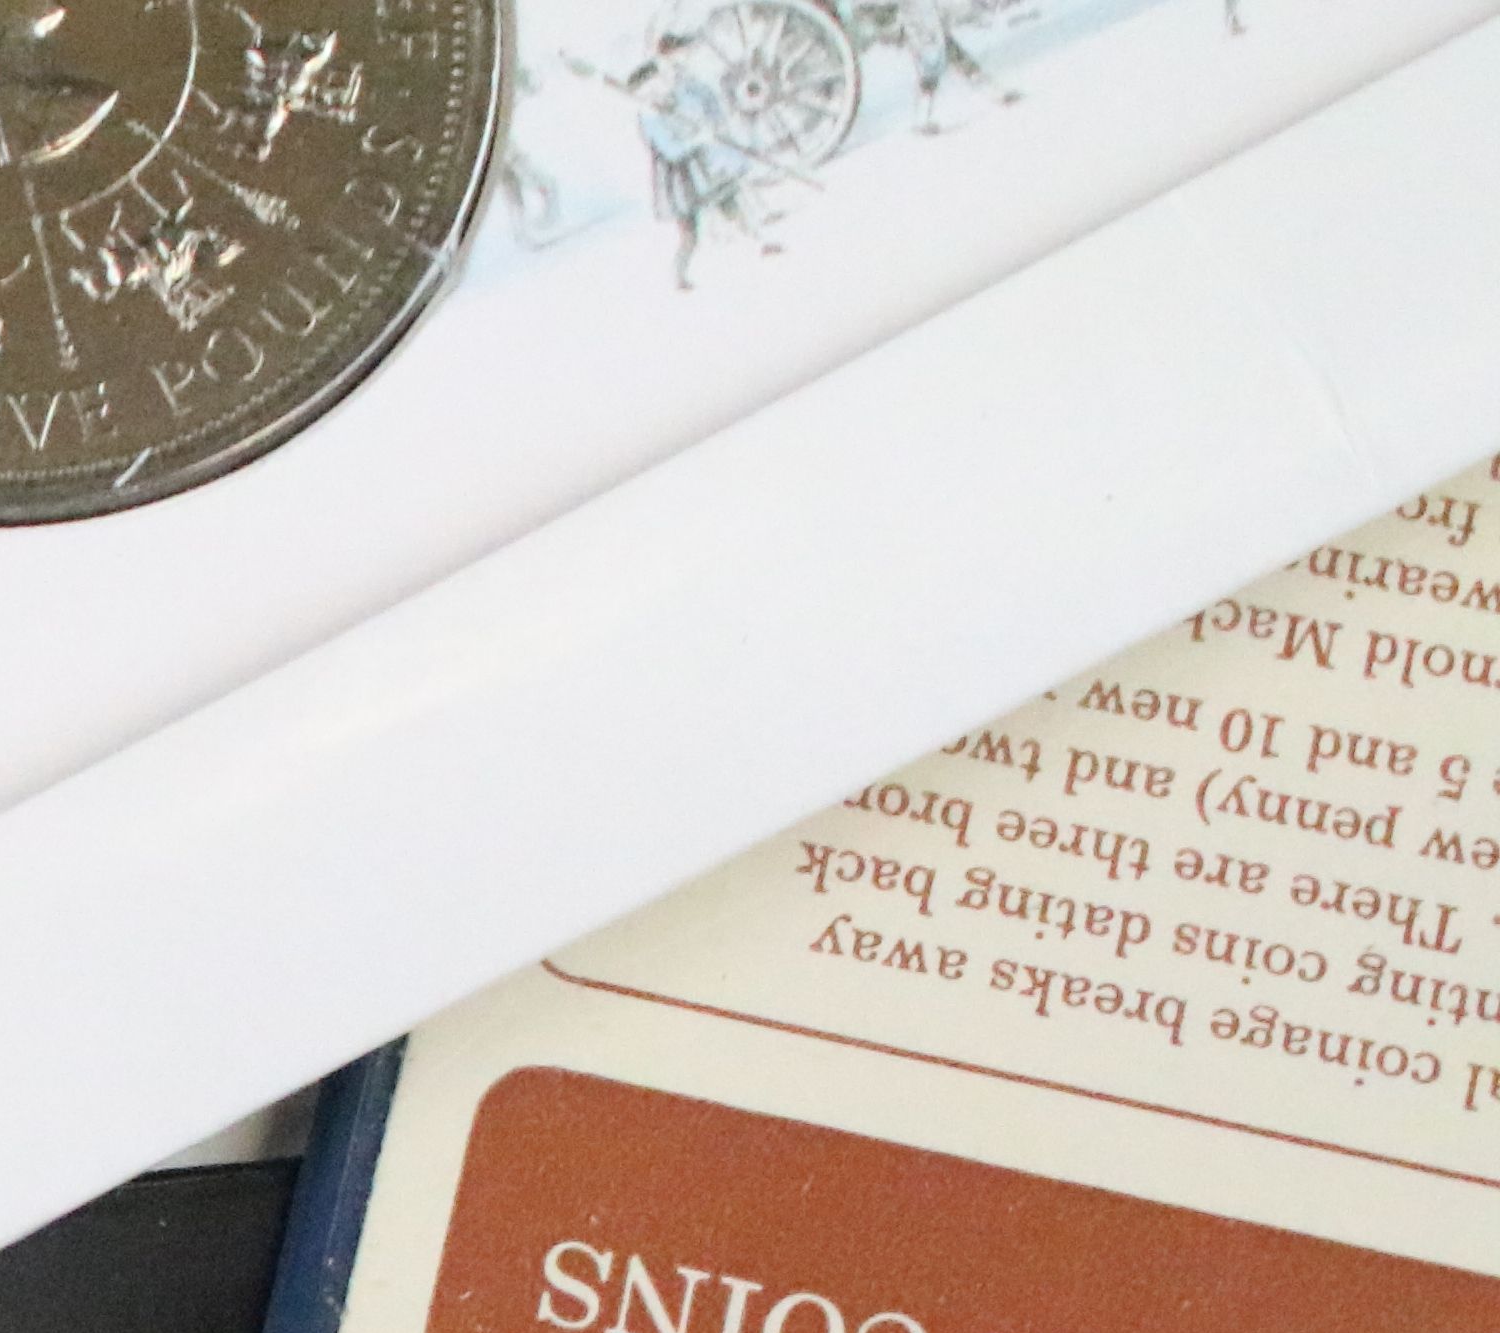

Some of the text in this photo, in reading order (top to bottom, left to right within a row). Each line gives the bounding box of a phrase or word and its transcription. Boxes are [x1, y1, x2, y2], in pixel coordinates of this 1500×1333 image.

[1078, 679, 1203, 731] new
[1218, 706, 1285, 758] 10
[1063, 747, 1176, 799] and
[1306, 723, 1418, 776] and
[1436, 753, 1472, 802] 5
[1195, 767, 1403, 849] penny)
[793, 839, 936, 913] back
[996, 808, 1150, 882] three
[1173, 846, 1270, 894] are
[955, 866, 1151, 958] dating
[1290, 873, 1462, 954] There
[810, 913, 968, 983] away
[1172, 922, 1328, 986] coins
[990, 959, 1187, 1047] breaks
[1210, 1004, 1442, 1088] coinage
